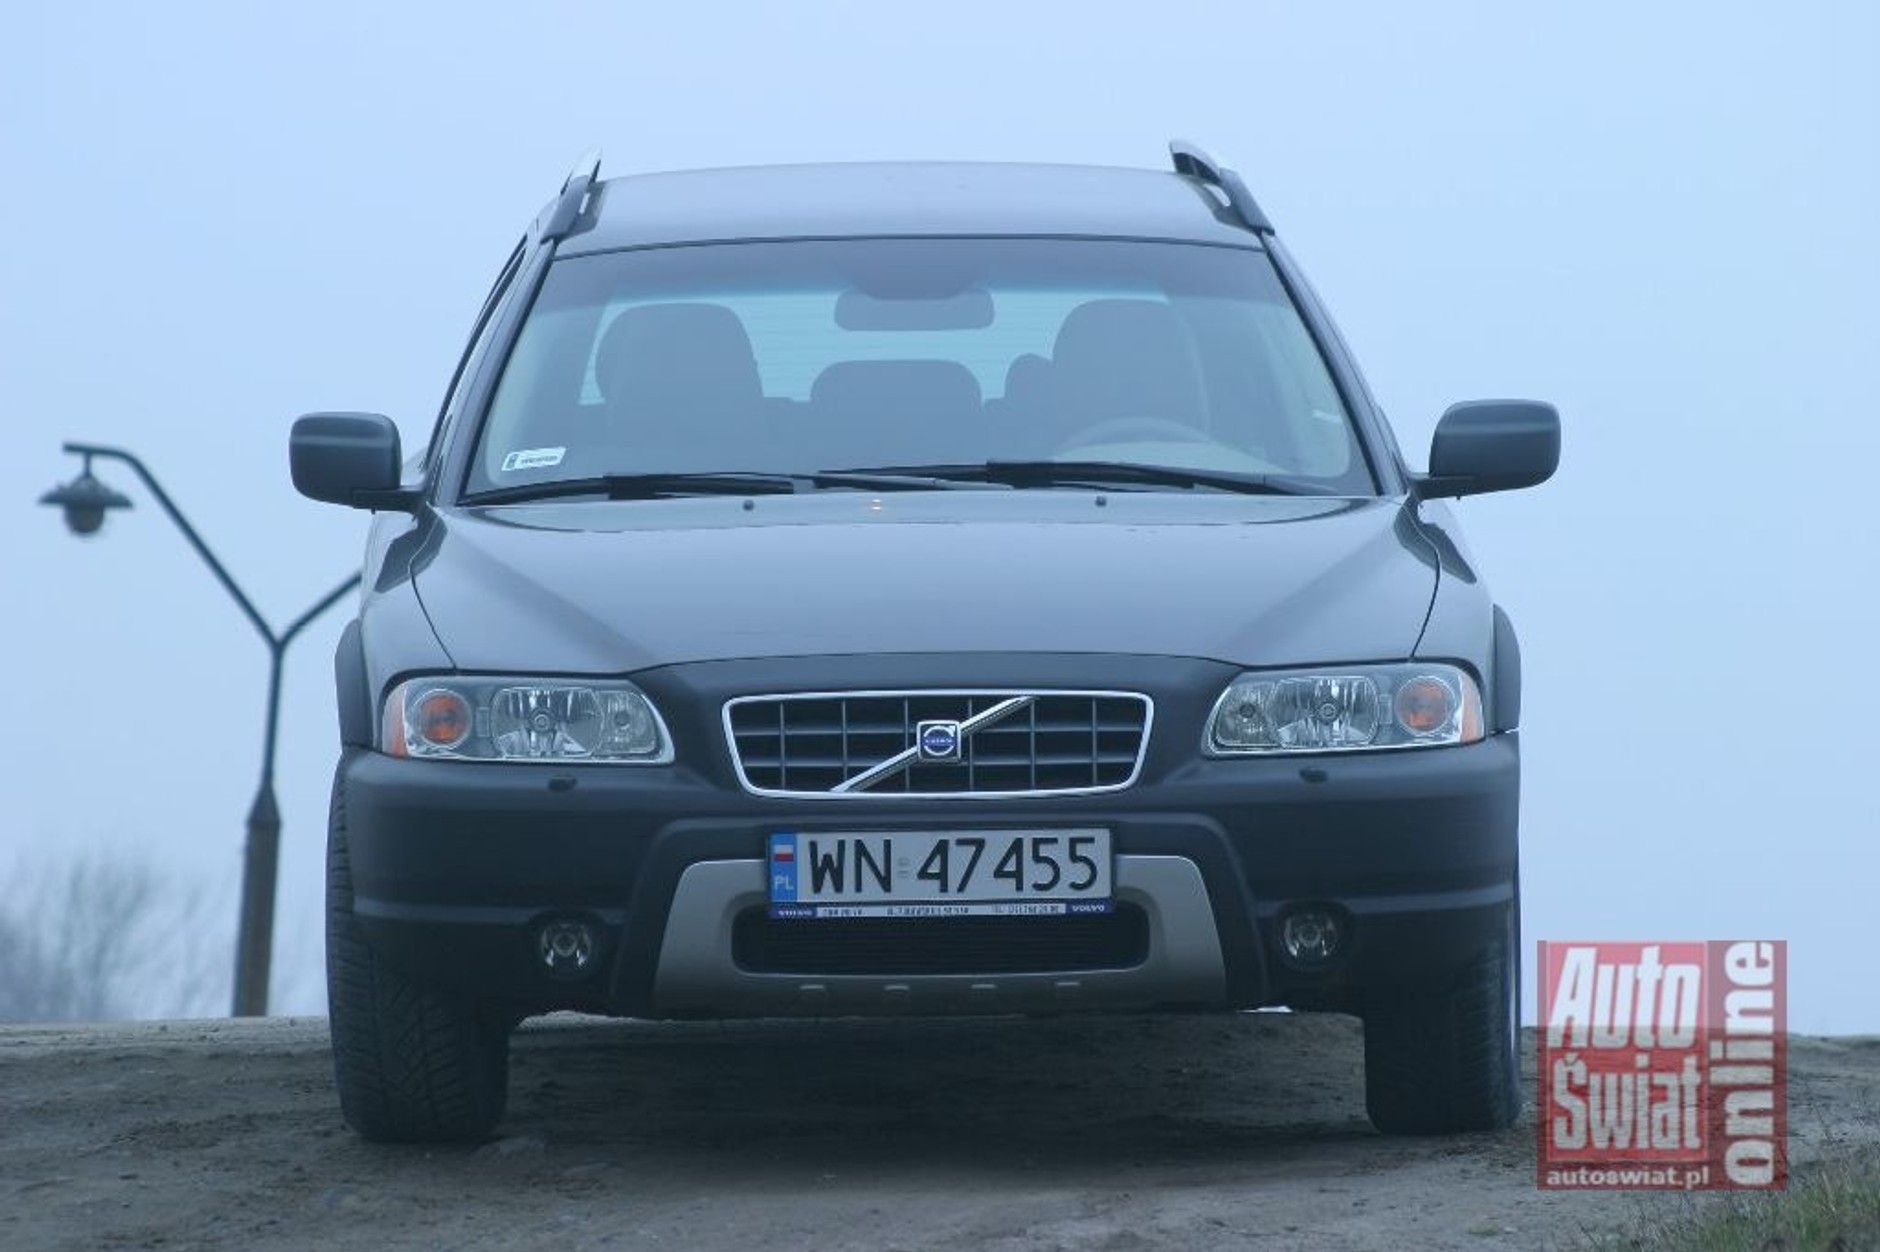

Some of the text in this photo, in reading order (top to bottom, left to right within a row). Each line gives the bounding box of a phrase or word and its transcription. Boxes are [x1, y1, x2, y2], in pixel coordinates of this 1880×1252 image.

[809, 836, 1098, 894] WN 47455
[774, 874, 795, 891] PL
[1071, 904, 1106, 913] VOLVO
